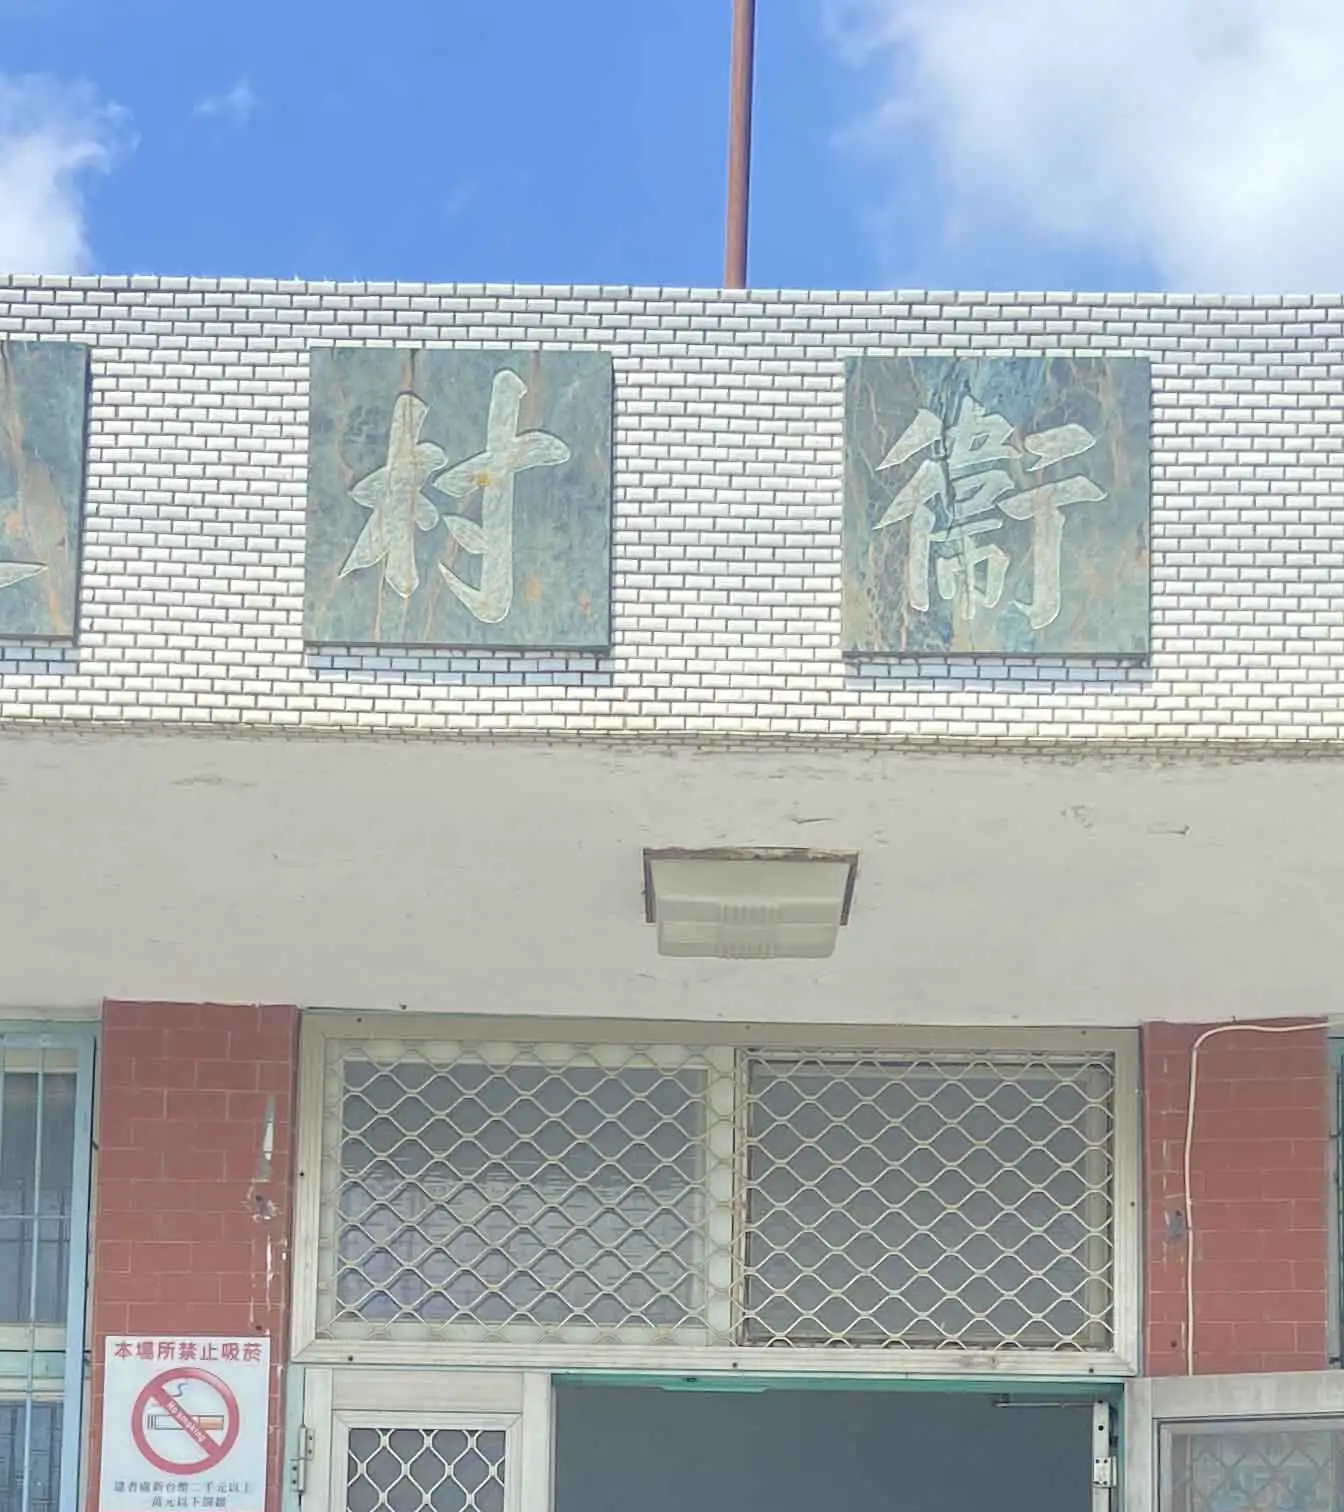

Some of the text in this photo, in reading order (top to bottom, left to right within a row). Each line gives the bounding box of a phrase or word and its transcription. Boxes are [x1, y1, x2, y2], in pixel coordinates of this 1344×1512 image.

[114, 1341, 262, 1362] 本場所禁止吸菸
